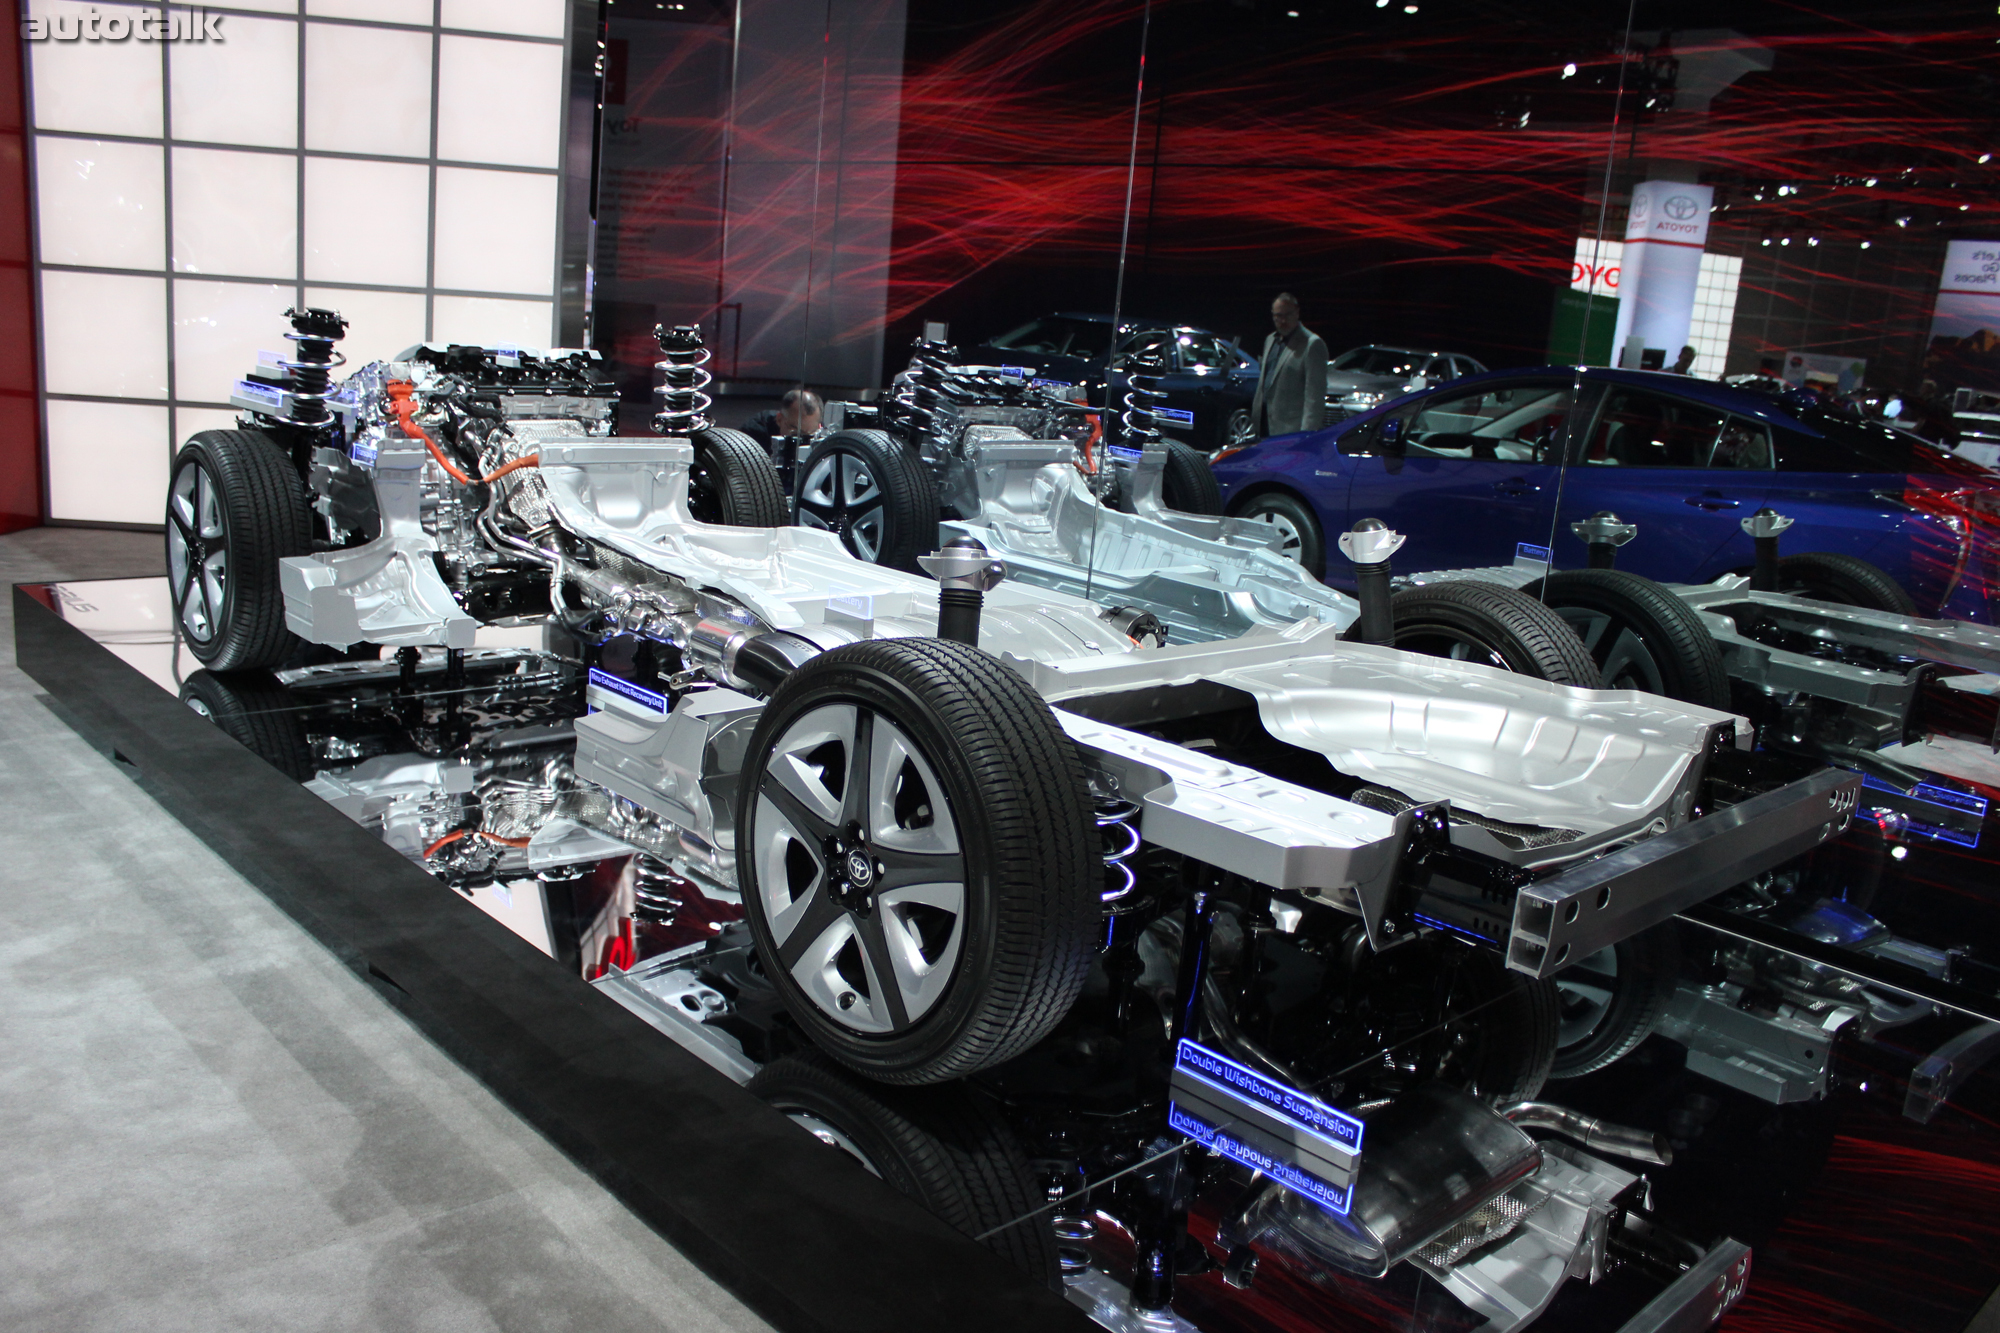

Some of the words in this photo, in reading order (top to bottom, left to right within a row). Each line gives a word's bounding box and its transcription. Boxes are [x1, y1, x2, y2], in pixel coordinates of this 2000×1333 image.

[1523, 545, 1547, 558] Battery
[601, 676, 619, 691] Exhaust
[1182, 1046, 1223, 1076] Double
[1224, 1068, 1282, 1105] Wishbone
[1283, 1096, 1355, 1140] Suspension
